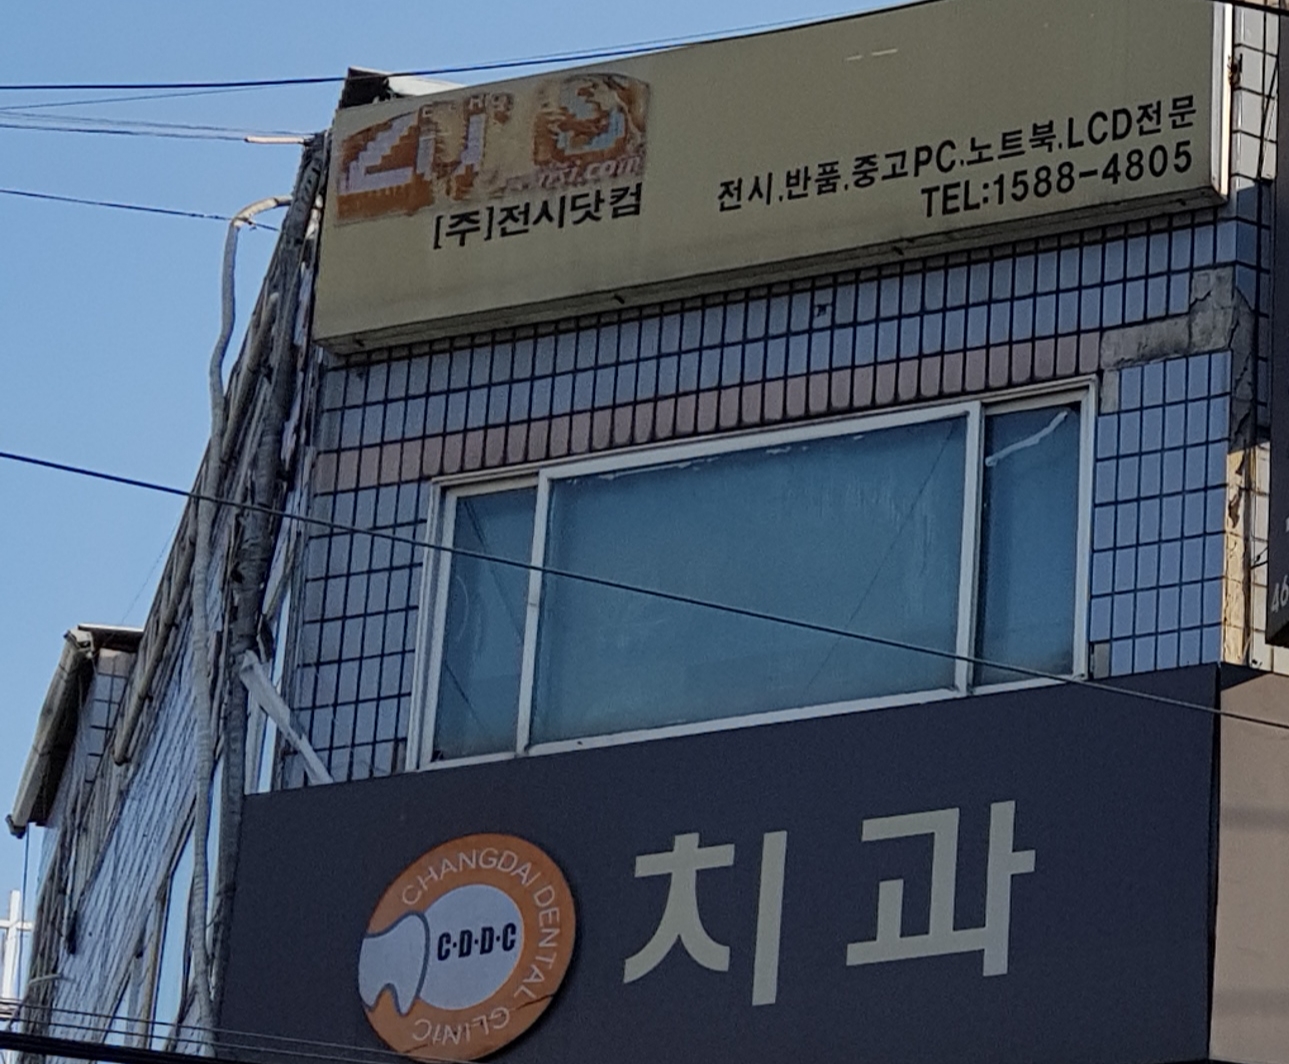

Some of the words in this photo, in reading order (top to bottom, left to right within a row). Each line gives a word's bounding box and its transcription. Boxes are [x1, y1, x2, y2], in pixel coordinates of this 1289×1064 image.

[433, 182, 643, 250] [주]전시닷컴
[920, 139, 1194, 218] TEL:1588-4805
[402, 847, 541, 905] CHANGDAI
[513, 885, 560, 1000] DENTAL
[623, 800, 1036, 1008] 치과
